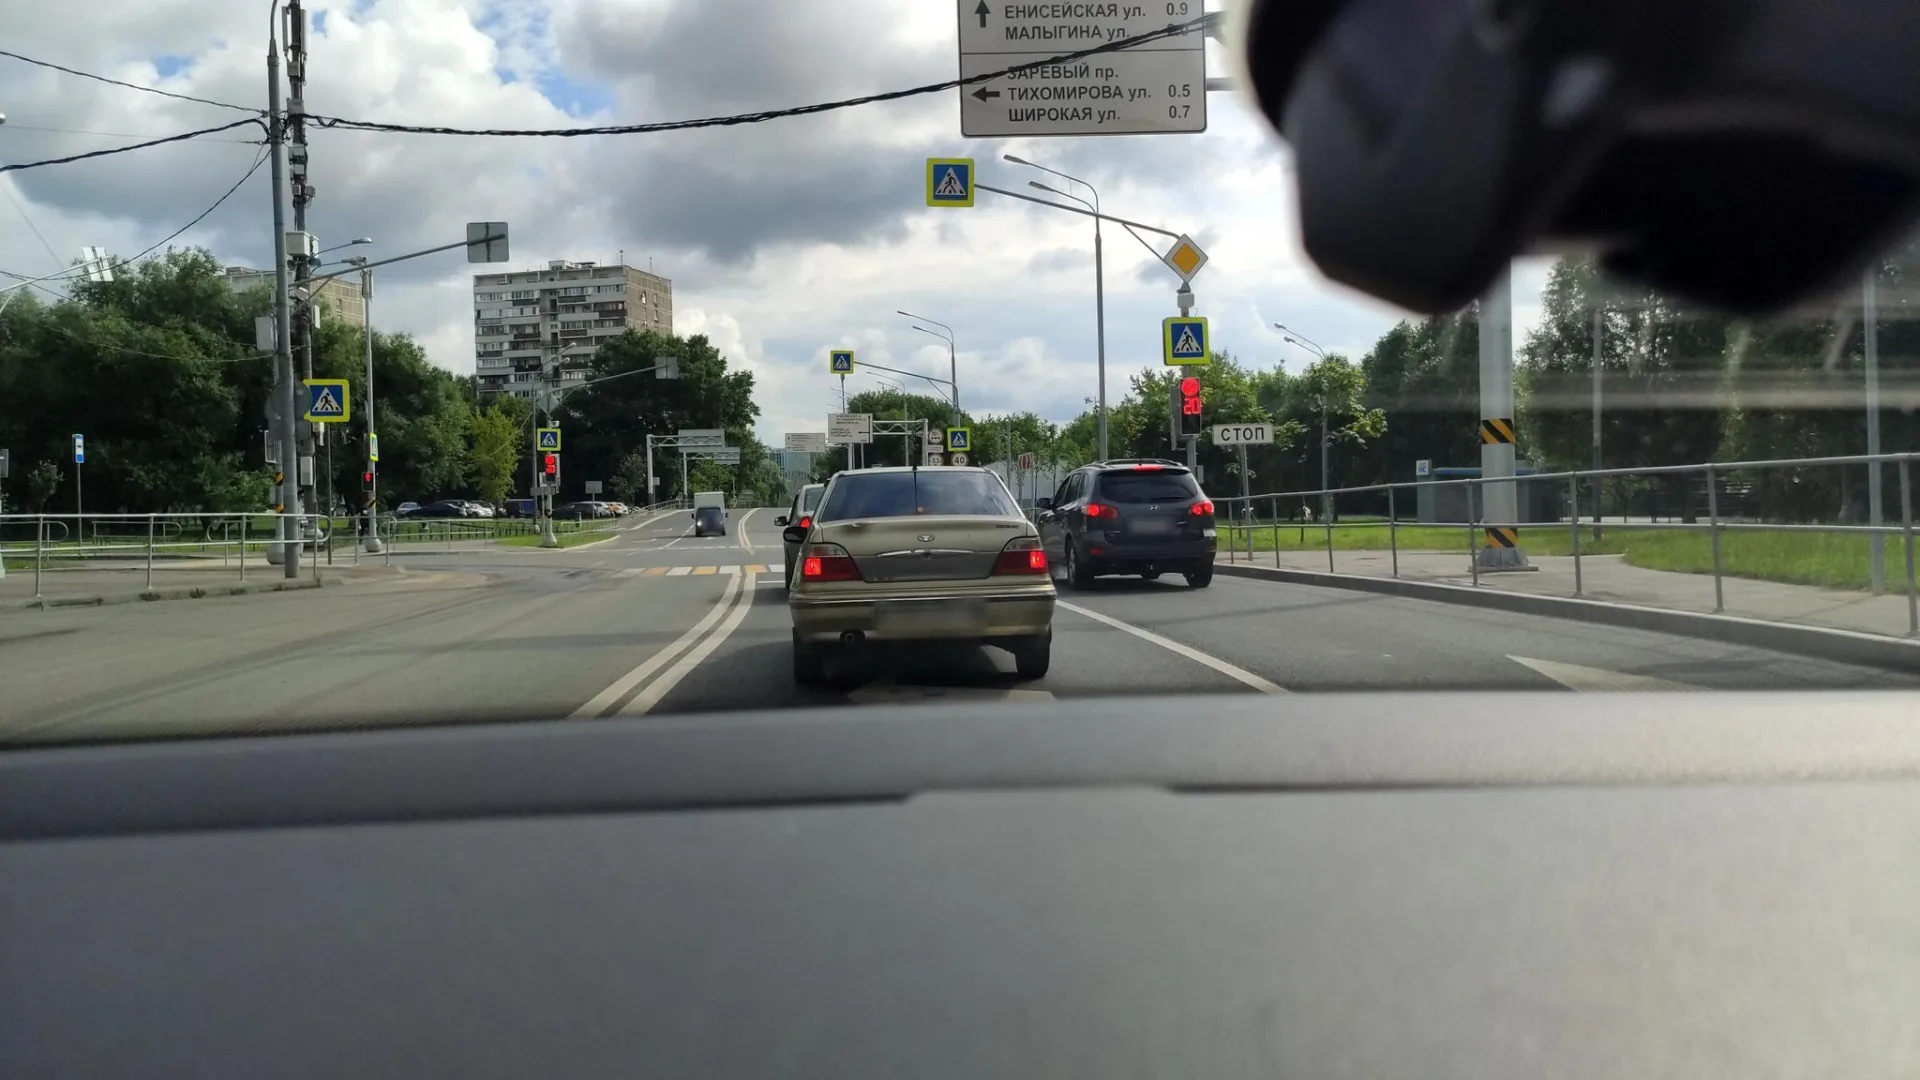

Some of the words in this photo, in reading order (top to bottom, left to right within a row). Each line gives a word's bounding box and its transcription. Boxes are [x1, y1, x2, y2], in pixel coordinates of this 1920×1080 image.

[1005, 0, 1117, 19] ЕНИСЕЙСКАЯ
[1122, 6, 1146, 20] ул.
[1166, 2, 1188, 16] 0.9
[1005, 25, 1102, 40] МАЛЫГИНА
[1106, 28, 1130, 42] ул.
[1007, 63, 1089, 80] ЗАРЕВЫЙ
[1095, 67, 1119, 81] пр.
[1007, 86, 1124, 101] ТИХОМИРОВА
[1128, 88, 1151, 102] ул.
[1168, 84, 1190, 98] 0.5
[1009, 107, 1092, 122] ШИРОКАЯ
[1098, 110, 1121, 124] ул.
[1169, 105, 1190, 119] 0.7
[1184, 397, 1201, 415] 20
[1221, 427, 1264, 441] СТОП
[954, 456, 965, 464] 40
